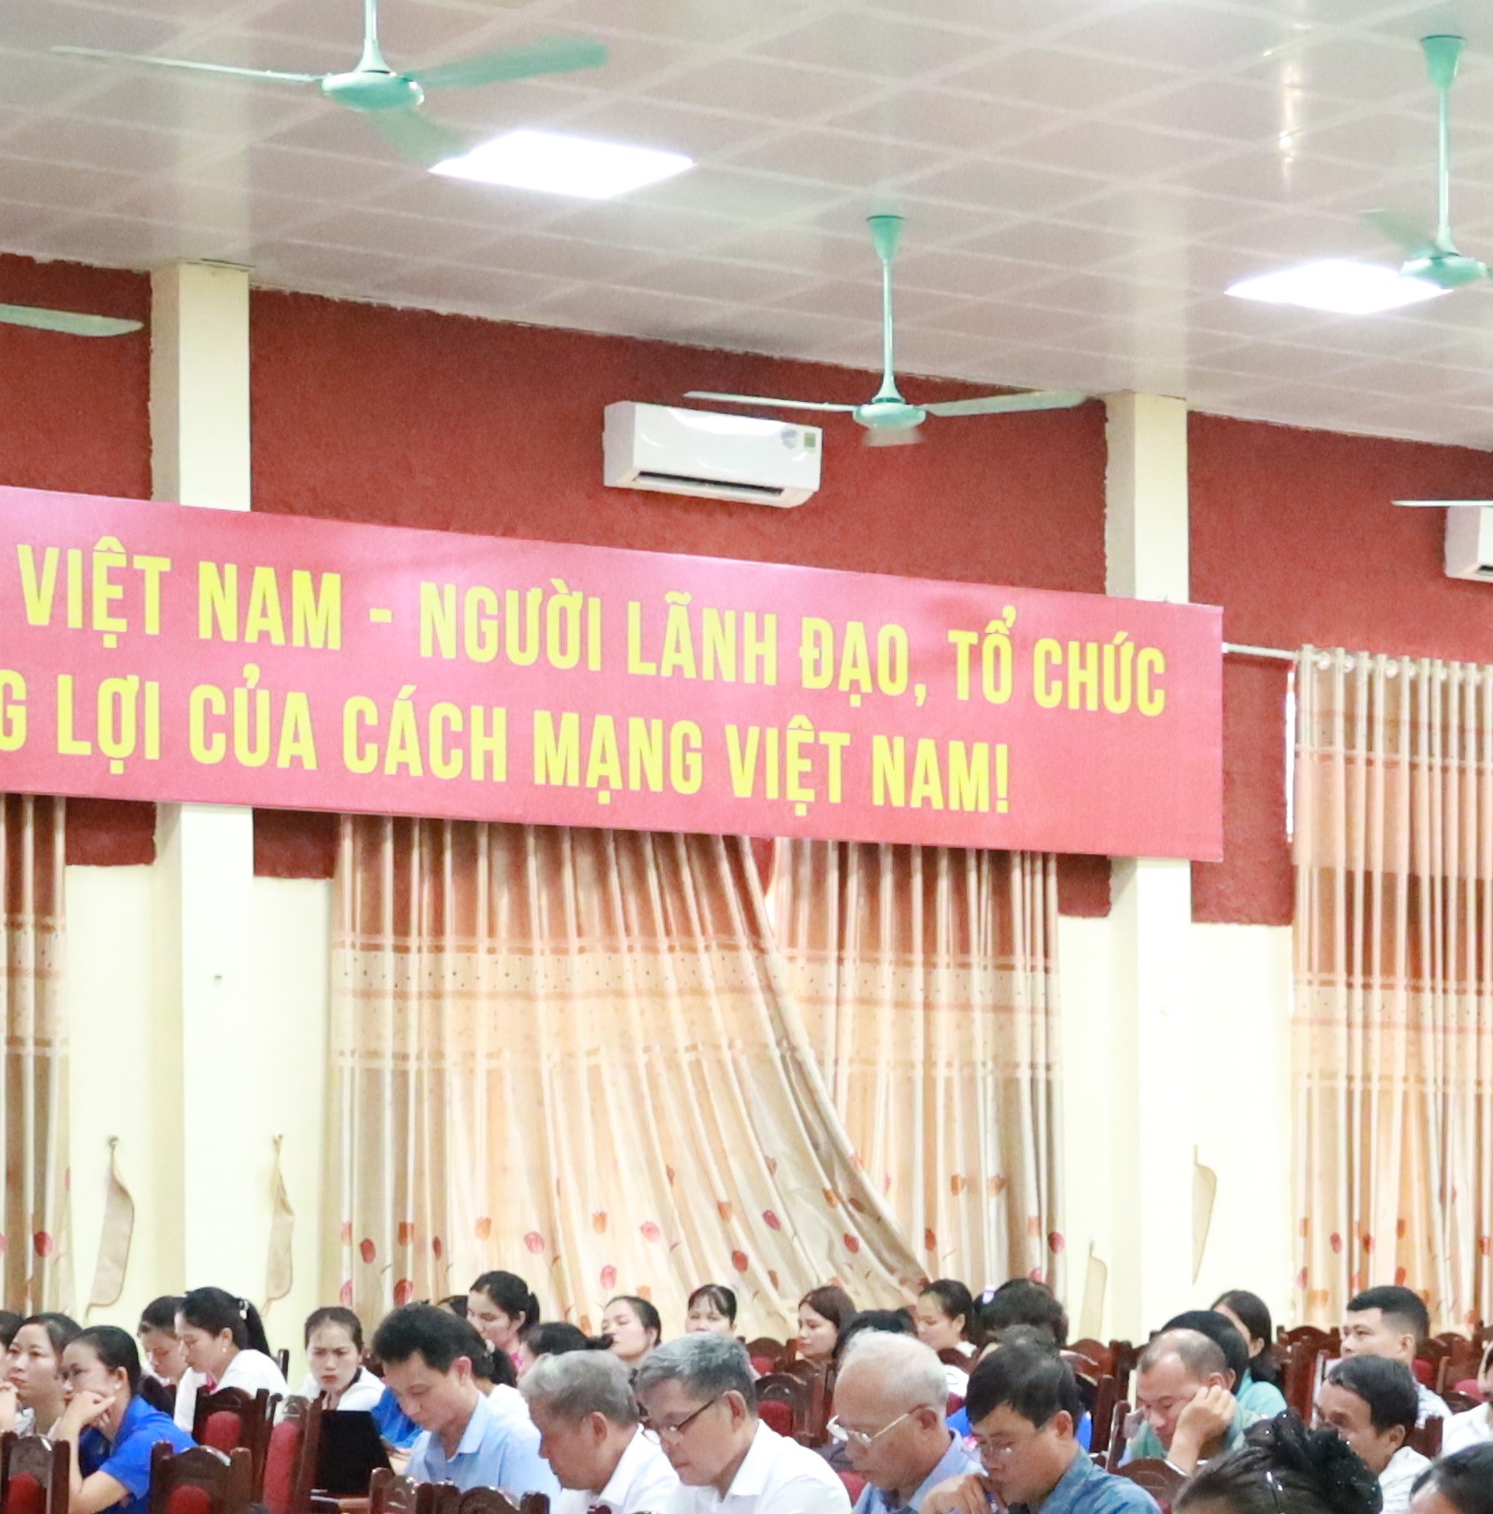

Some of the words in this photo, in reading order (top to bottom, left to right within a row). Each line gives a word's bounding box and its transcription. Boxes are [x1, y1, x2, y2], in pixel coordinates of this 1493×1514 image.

[17, 536, 172, 648] VIỆT
[198, 561, 342, 649] NAM
[370, 608, 392, 622] -
[420, 579, 602, 671] NGƯỜI
[628, 591, 777, 685] LÃNH
[800, 618, 927, 706] ĐẠO,
[948, 605, 1017, 704] TỔ
[1033, 631, 1166, 716] CHỨC
[57, 674, 161, 774] LỢI
[189, 663, 318, 769] CỦA
[343, 685, 508, 781] CÁCH
[533, 710, 704, 804] MẠNG
[725, 715, 852, 816] VIỆT
[872, 735, 1011, 813] NAM!
